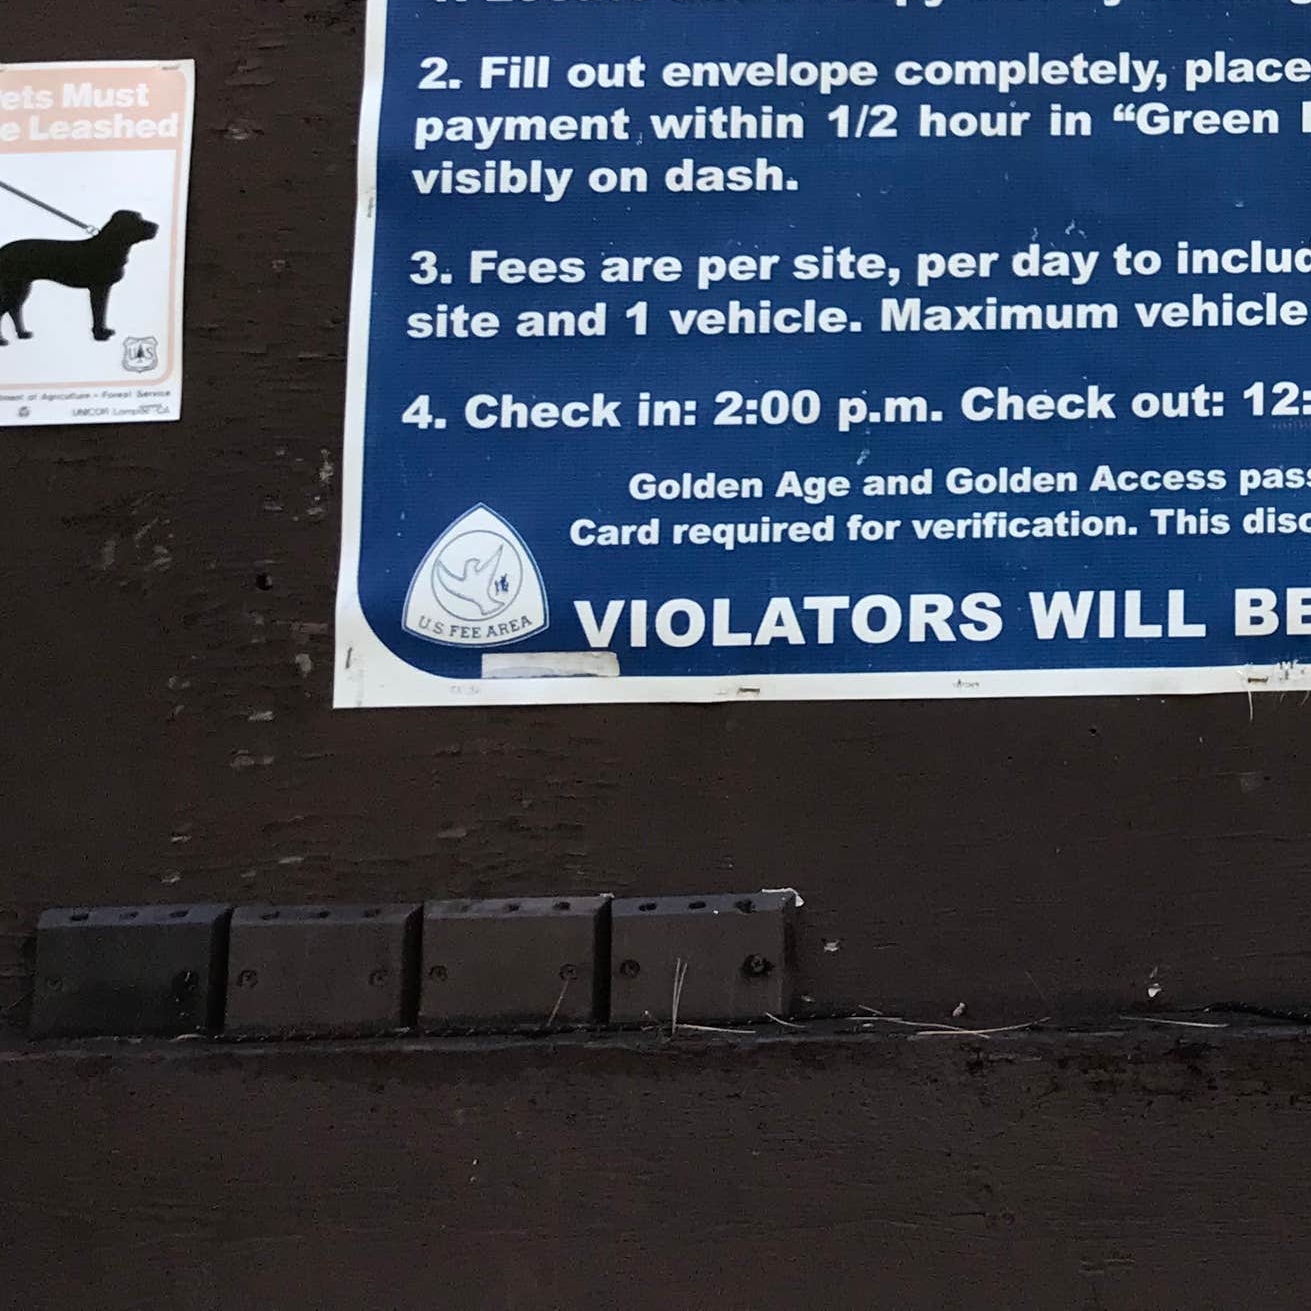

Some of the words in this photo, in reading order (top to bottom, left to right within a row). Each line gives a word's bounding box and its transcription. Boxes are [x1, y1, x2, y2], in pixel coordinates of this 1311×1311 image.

[419, 57, 462, 89] 2.
[481, 56, 549, 88] Fill
[568, 56, 645, 87] out
[663, 54, 877, 94] envelope
[895, 52, 1166, 92] completely,
[1186, 51, 1311, 91] place
[0, 86, 54, 110] ets
[62, 82, 150, 108] Must
[29, 112, 180, 141] Leashed
[402, 395, 446, 428] 4.
[465, 393, 620, 428] Check
[639, 393, 696, 426] in:
[714, 390, 820, 425] 2:00
[839, 397, 942, 431] p.m.
[962, 385, 1115, 421] Check
[1132, 384, 1223, 418] out:
[570, 519, 659, 545] Card
[673, 516, 834, 550] required
[847, 515, 901, 540] for
[912, 511, 1137, 539] verification.
[1151, 509, 1230, 534] This
[449, 624, 482, 639] FEE
[486, 615, 533, 638] AREA
[573, 593, 1002, 648] VIOLATORS
[1029, 590, 1206, 639] WILL
